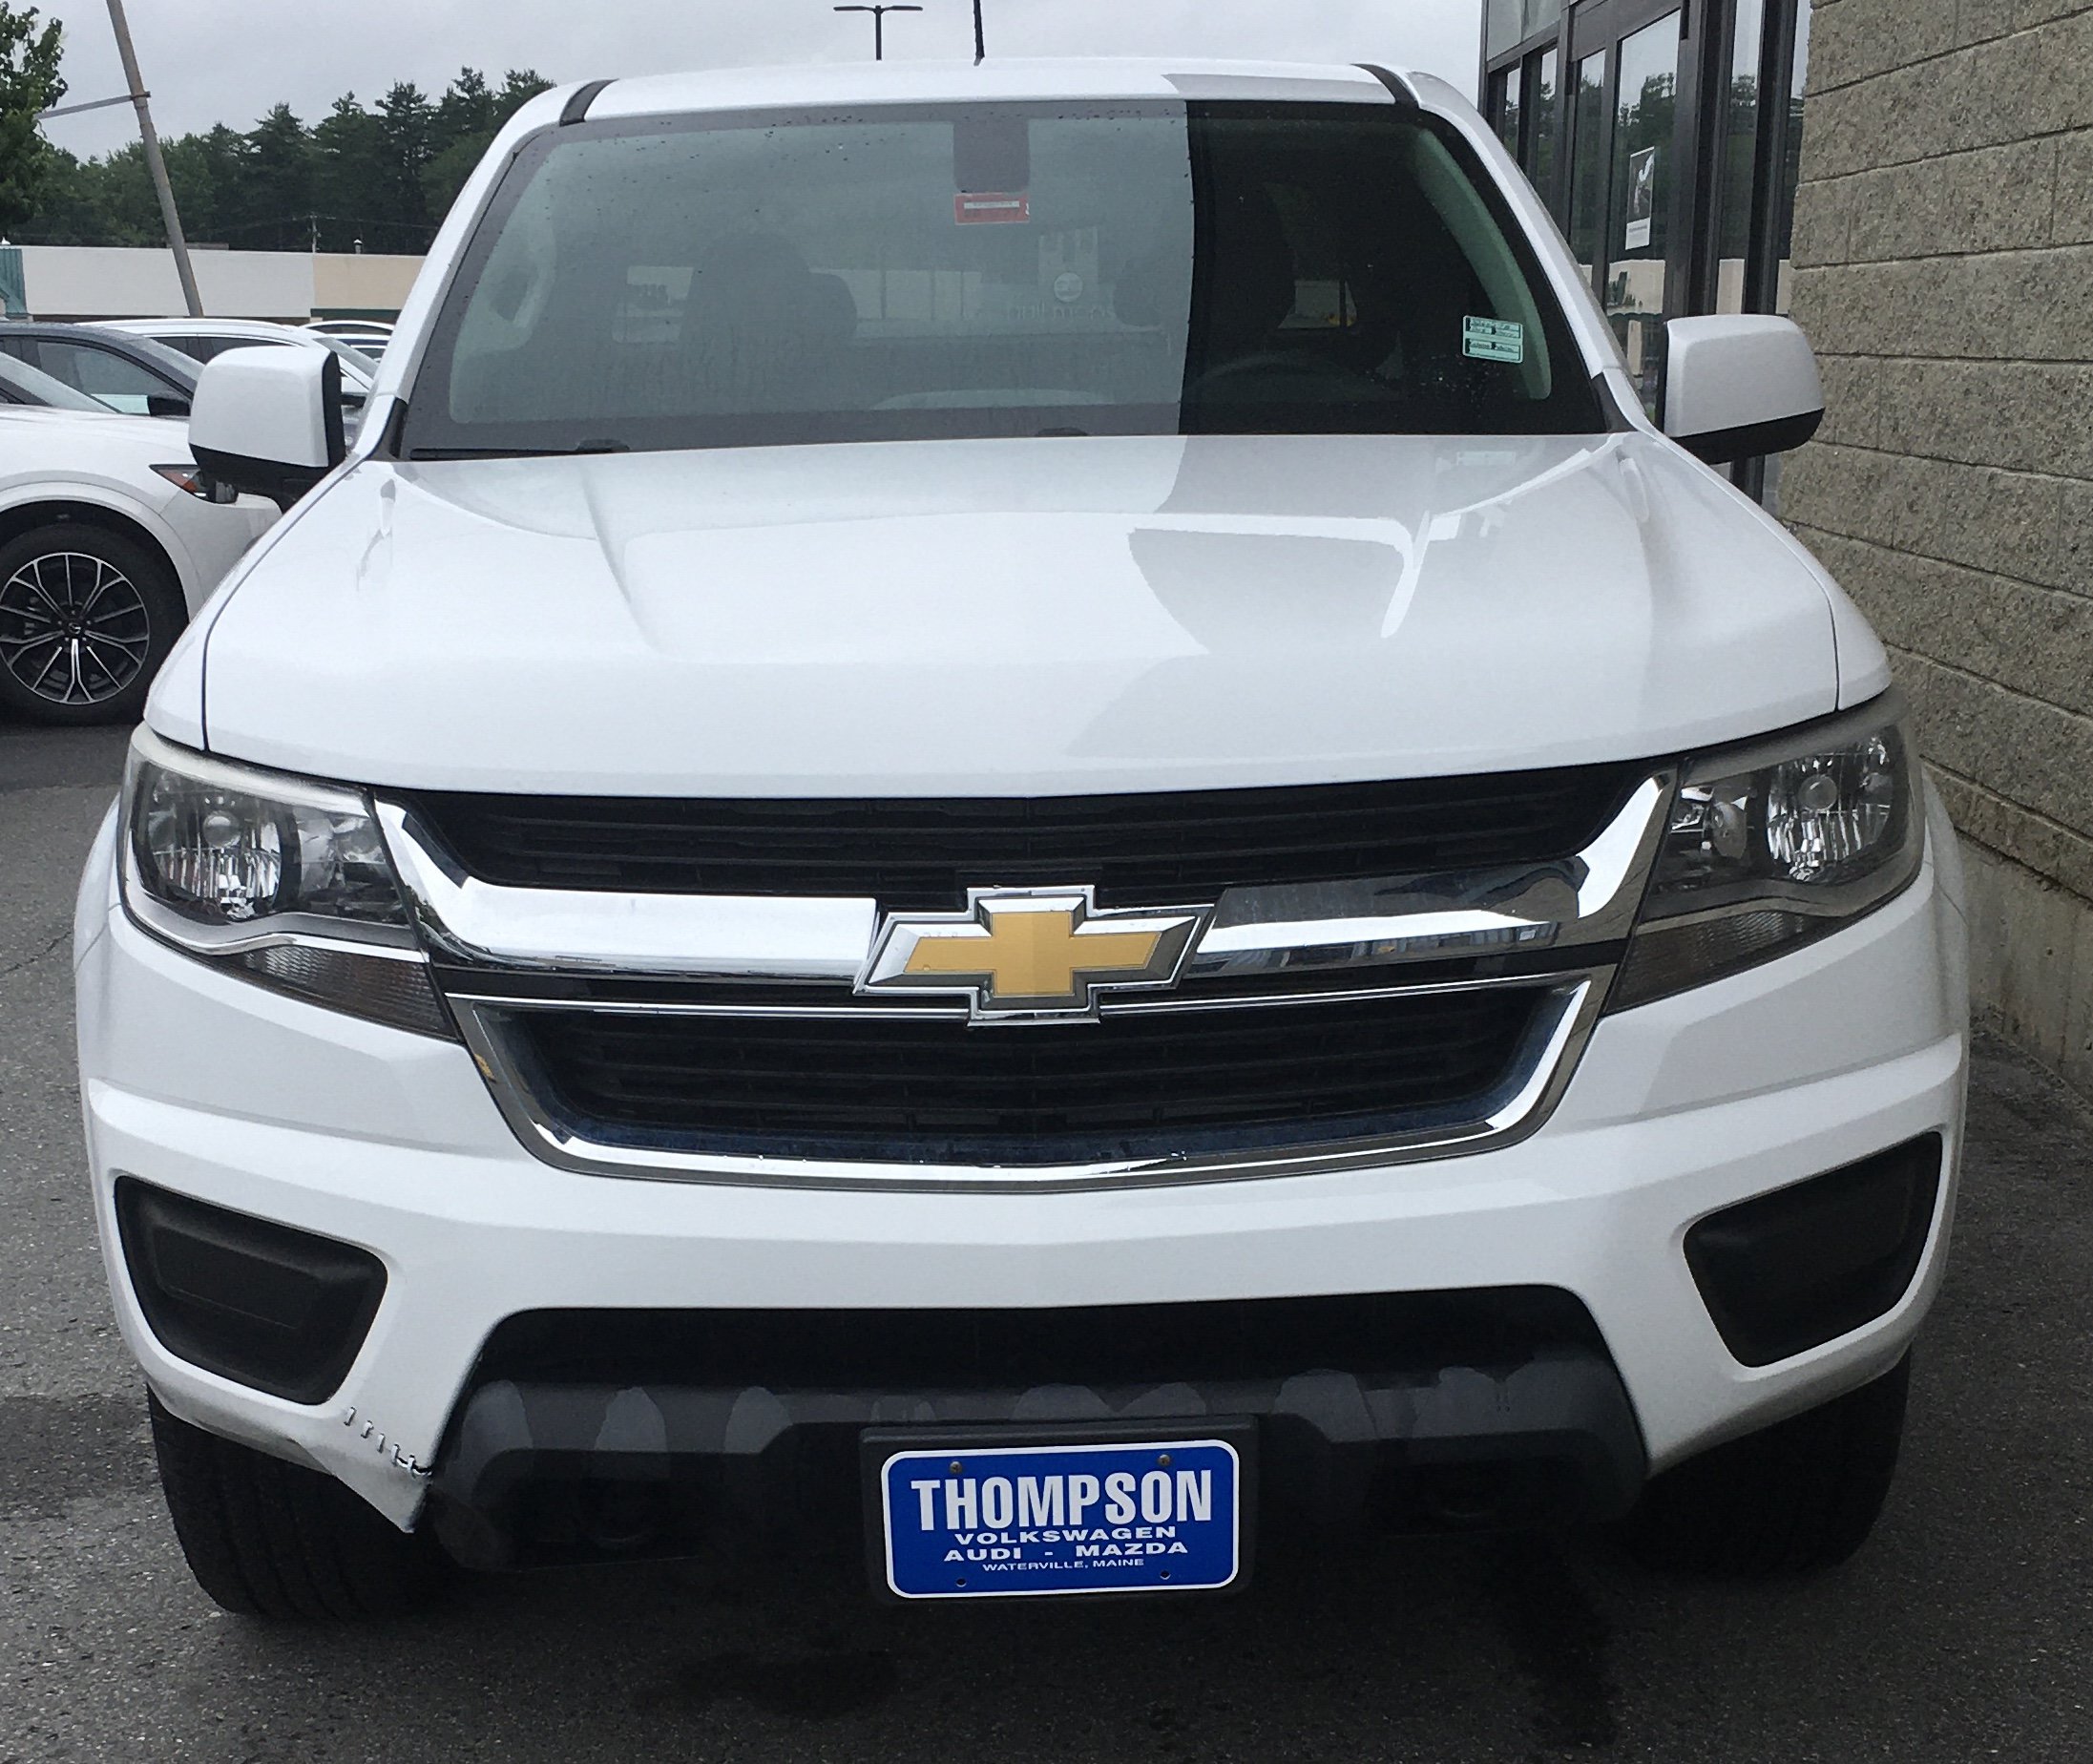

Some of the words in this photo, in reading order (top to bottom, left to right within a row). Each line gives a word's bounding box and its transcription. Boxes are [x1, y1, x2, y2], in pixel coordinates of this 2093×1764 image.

[911, 1470, 1211, 1530] THOMPSON
[954, 1525, 1176, 1545] VOLKSWAGEN
[943, 1546, 1021, 1562] AUDI
[1076, 1541, 1188, 1558] MAZDA
[982, 1560, 1089, 1572] WATERVILLE,
[1092, 1558, 1144, 1567] MAINE
